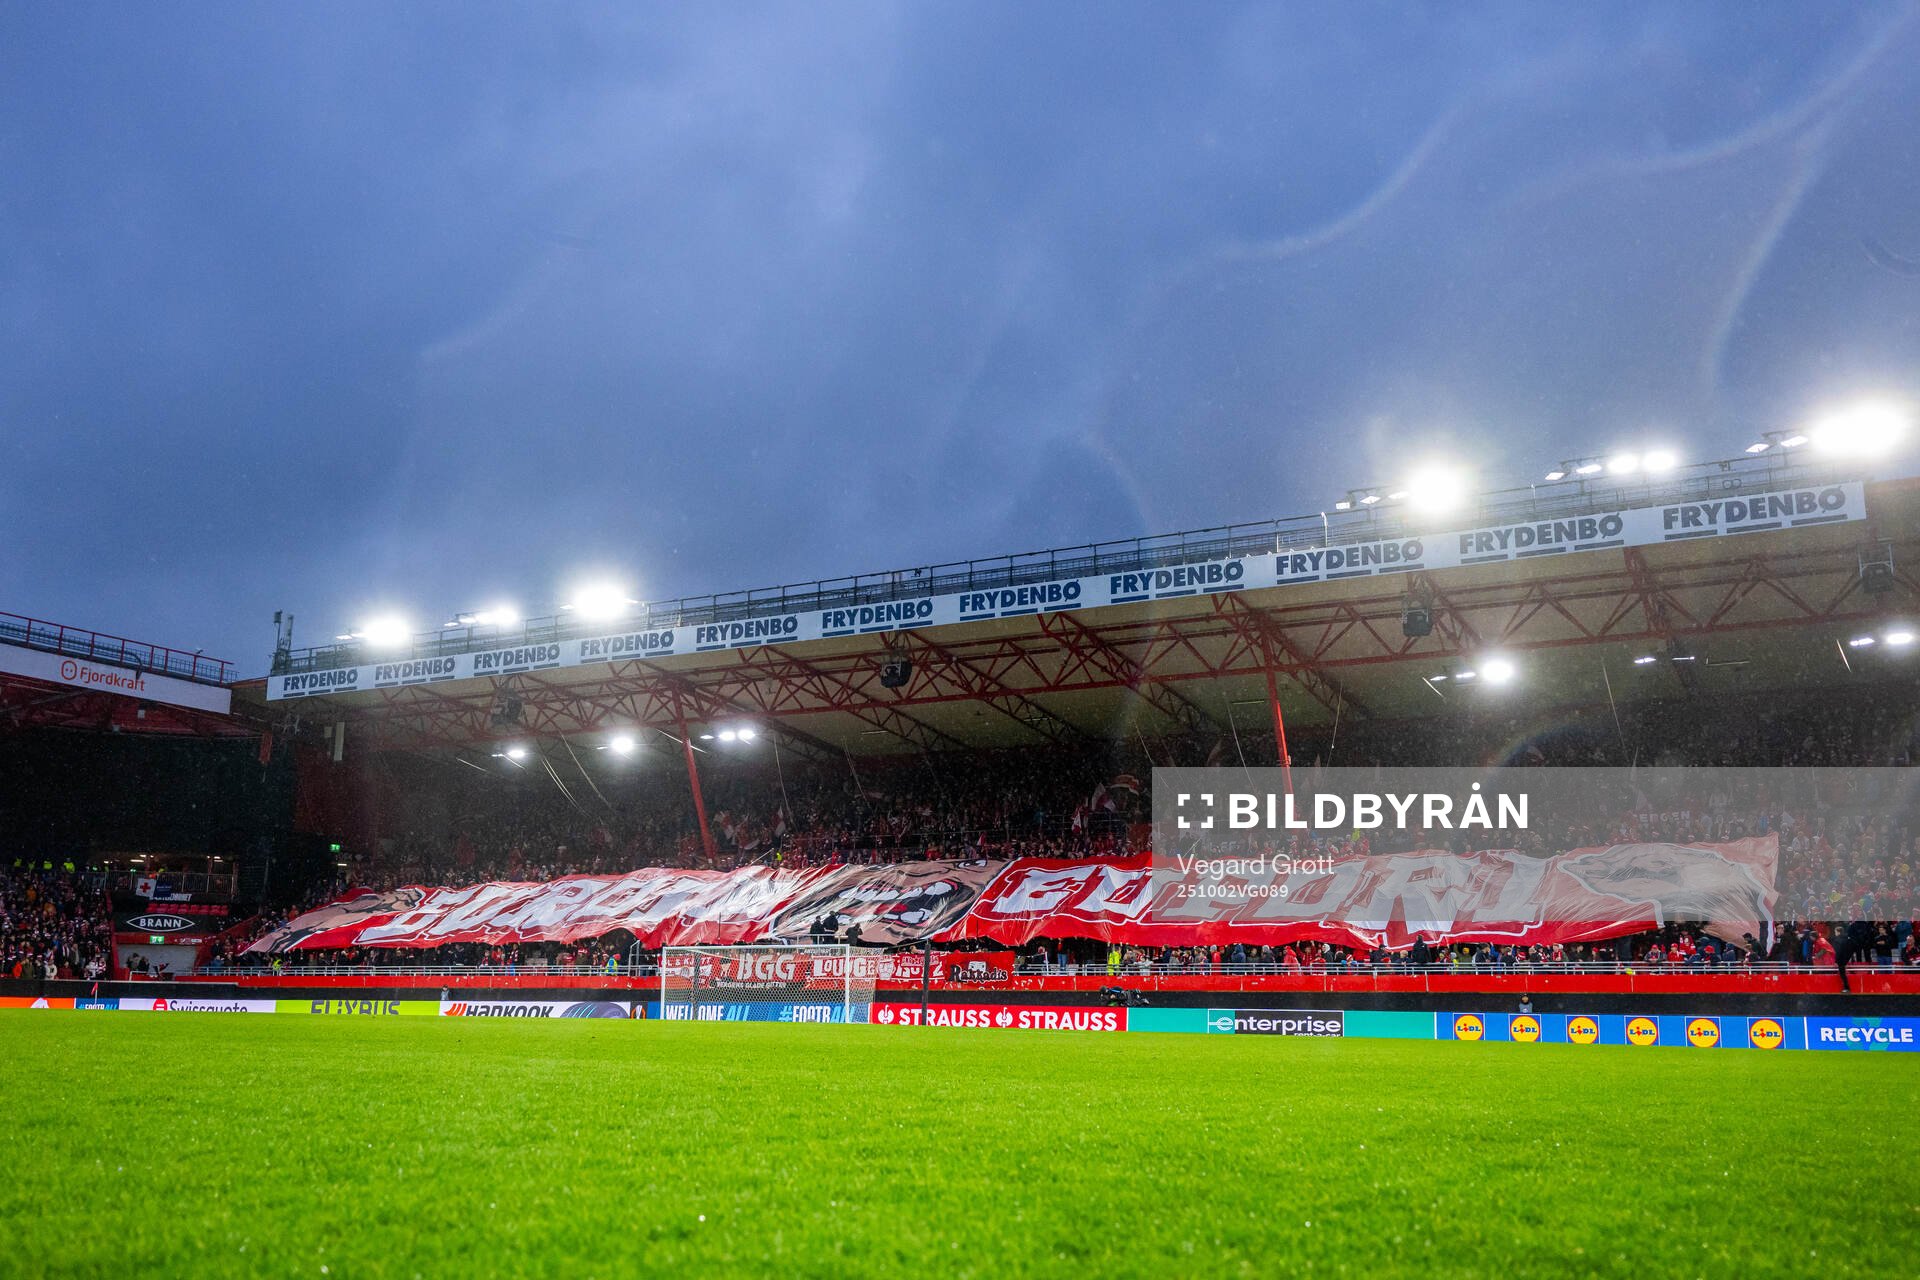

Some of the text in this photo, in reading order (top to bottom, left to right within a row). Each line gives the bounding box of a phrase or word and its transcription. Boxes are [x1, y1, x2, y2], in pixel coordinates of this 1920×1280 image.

[1663, 485, 1846, 530] FRYDENBØ
[1460, 512, 1623, 554] FRYDENBØ
[1277, 537, 1424, 575] FRYDENBØ
[1110, 559, 1244, 594] FRYDENBØ
[960, 579, 1081, 612] FRYDENBØ
[822, 598, 933, 629] FRYDENBØ
[696, 615, 798, 643] FRYDENBØ
[474, 642, 560, 669] FRYDENBØ
[581, 630, 674, 656] FRYDENBØ
[80, 666, 145, 691] Fjordkraft
[284, 669, 358, 690] FRYDENBØ
[375, 656, 456, 680] FRYDENBØ
[139, 918, 182, 928] BRANN
[736, 952, 797, 980] BGG
[666, 1005, 724, 1020] WELOME
[899, 1008, 1117, 1031] STRAUSS STRAUSS
[1215, 1016, 1342, 1035] enterprise
[1820, 1027, 1914, 1043] RECYCLE
